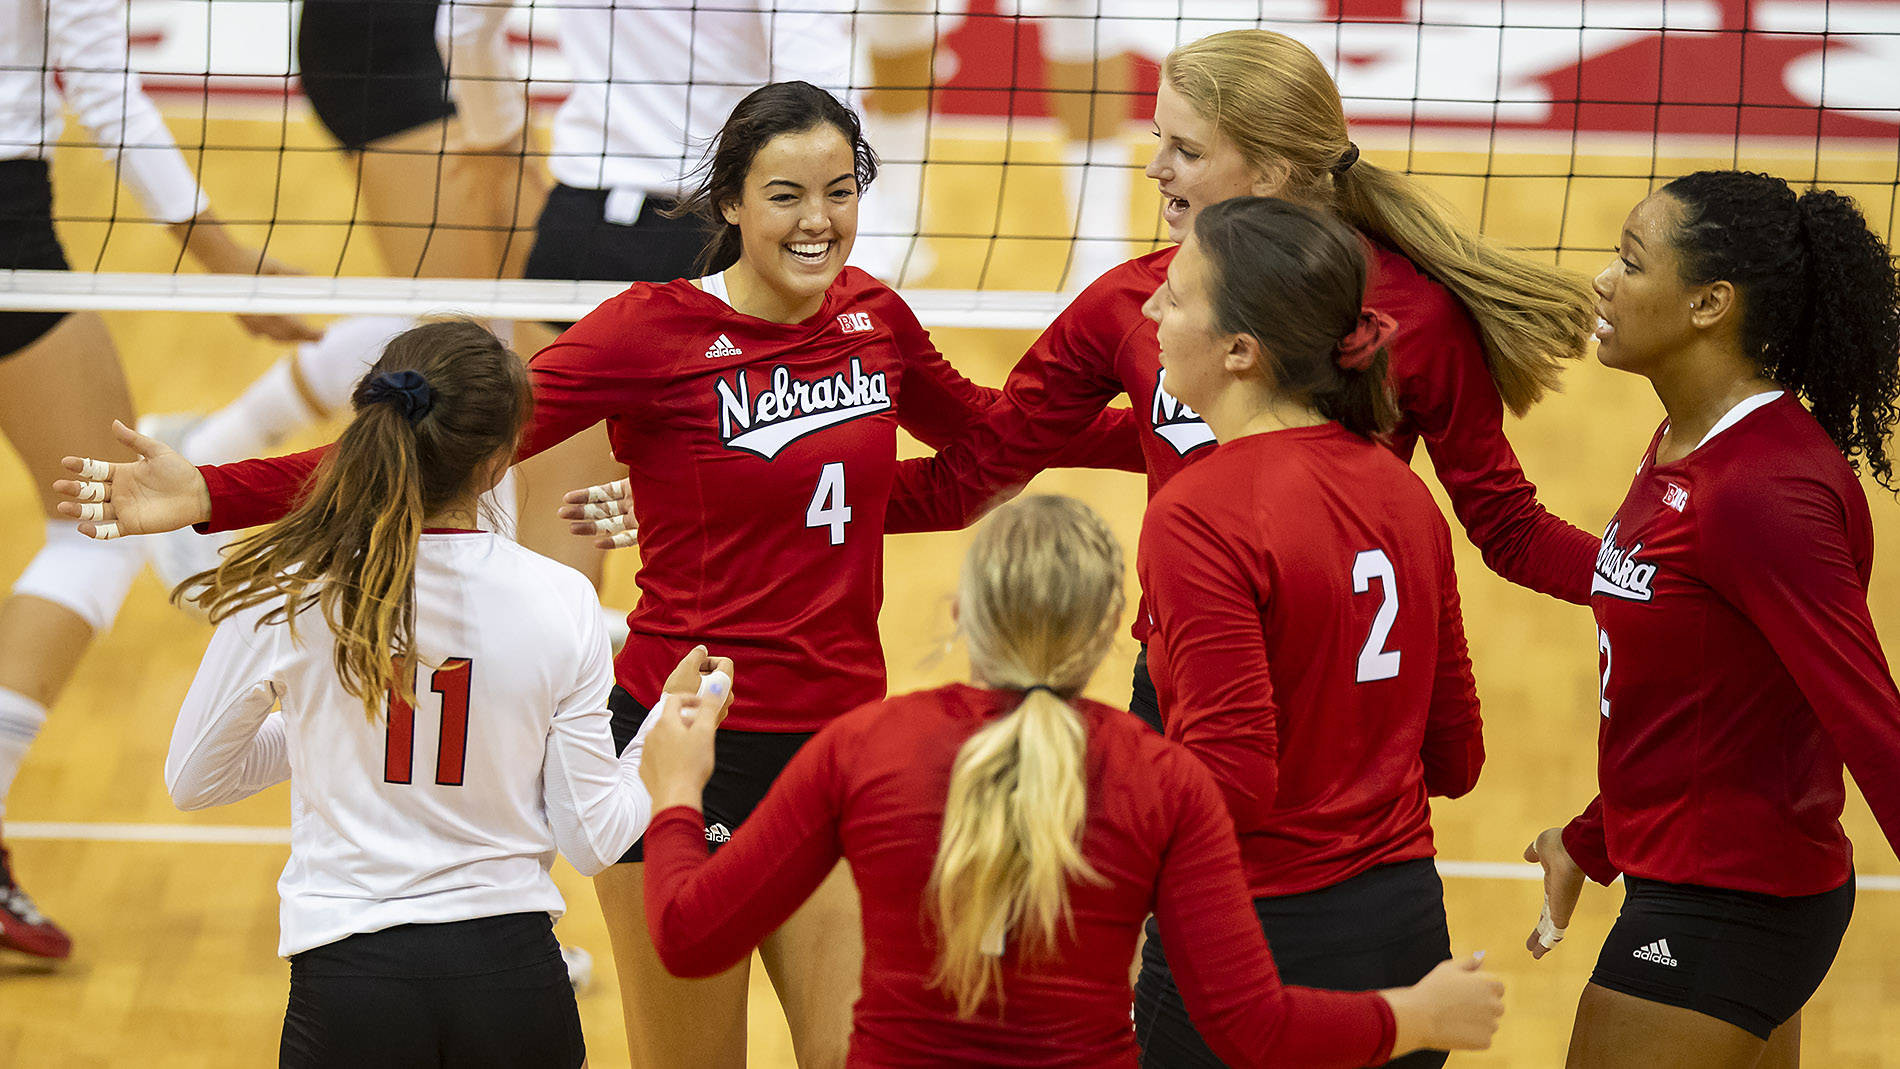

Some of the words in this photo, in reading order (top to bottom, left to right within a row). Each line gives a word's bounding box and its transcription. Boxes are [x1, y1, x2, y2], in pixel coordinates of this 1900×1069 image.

[705, 348, 743, 358] adidas
[715, 357, 889, 439] Nebraska
[805, 461, 852, 546] 4
[1351, 548, 1401, 683] 2
[384, 654, 473, 786] 11
[704, 832, 731, 843] dida
[1632, 950, 1678, 967] adidas
